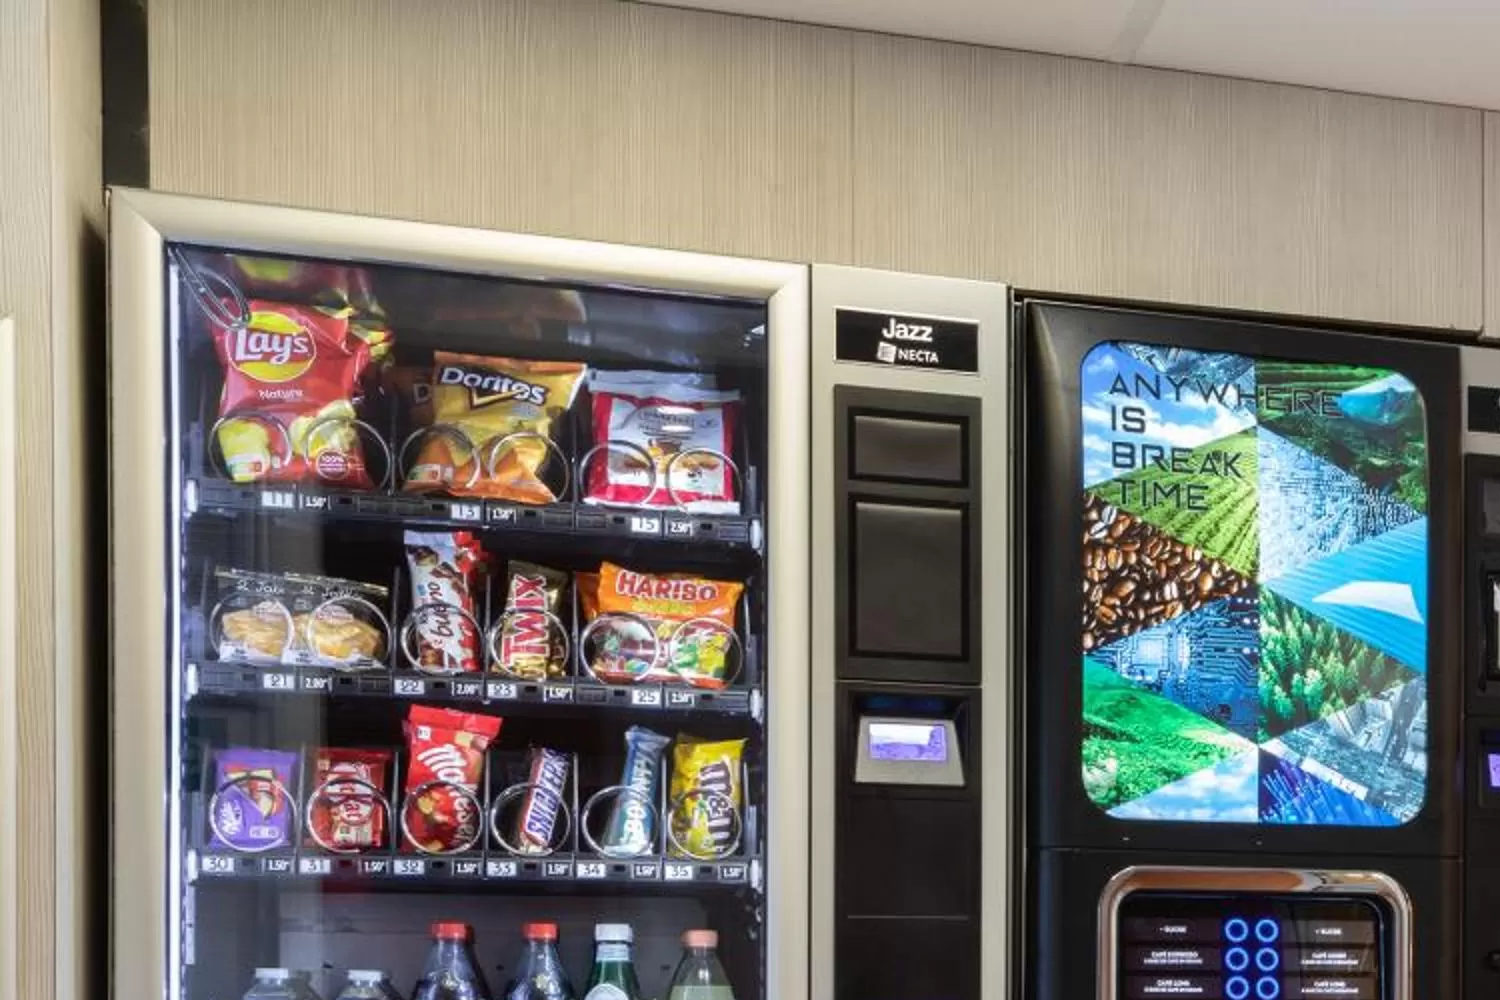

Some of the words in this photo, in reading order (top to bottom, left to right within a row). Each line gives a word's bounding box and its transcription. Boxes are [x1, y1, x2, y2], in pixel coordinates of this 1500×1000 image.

[235, 327, 309, 364] Lay's
[882, 318, 933, 342] Jazz
[898, 348, 938, 363] NECTA
[440, 367, 546, 405] Doritos
[1109, 371, 1344, 418] ANYWHERE
[1110, 406, 1146, 433] IS
[1112, 442, 1243, 478] BREAK
[1112, 479, 1209, 512] TIME
[616, 570, 719, 600] HARIBO
[428, 581, 454, 637] bueno
[503, 575, 549, 667] TWIX
